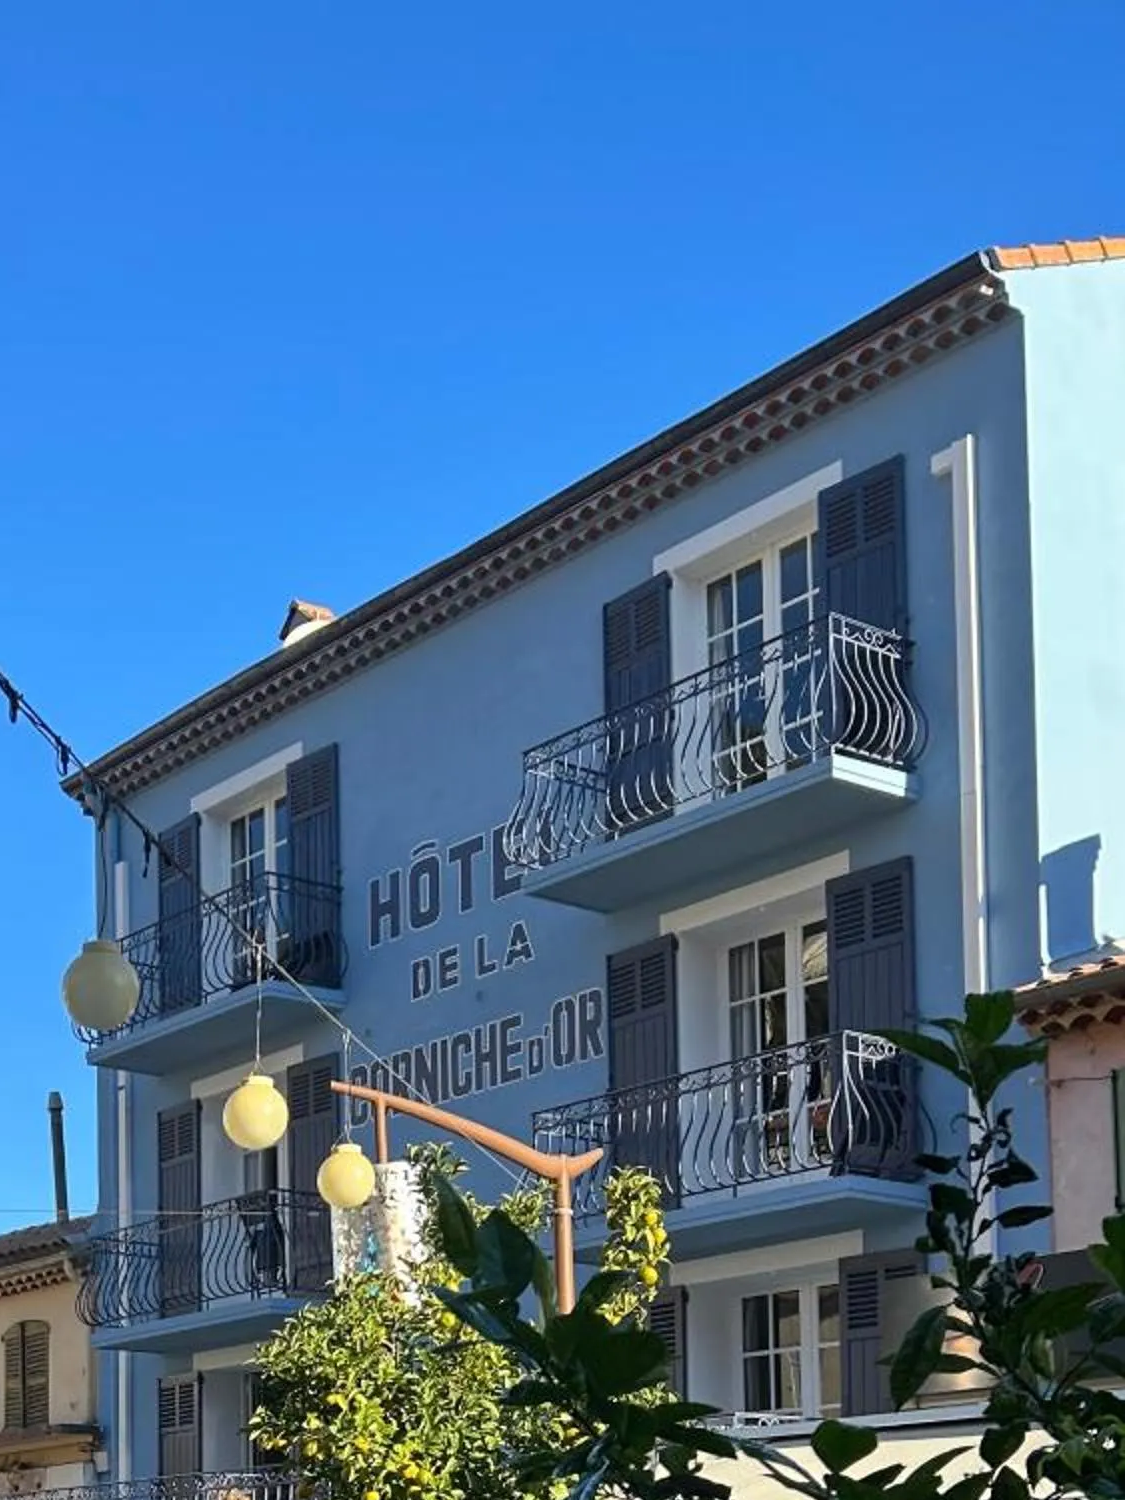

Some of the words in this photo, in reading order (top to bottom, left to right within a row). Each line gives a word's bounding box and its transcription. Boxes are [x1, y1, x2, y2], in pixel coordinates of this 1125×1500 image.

[411, 944, 461, 1001] DE
[475, 920, 535, 981] LA
[349, 1014, 524, 1129] CORNICHE
